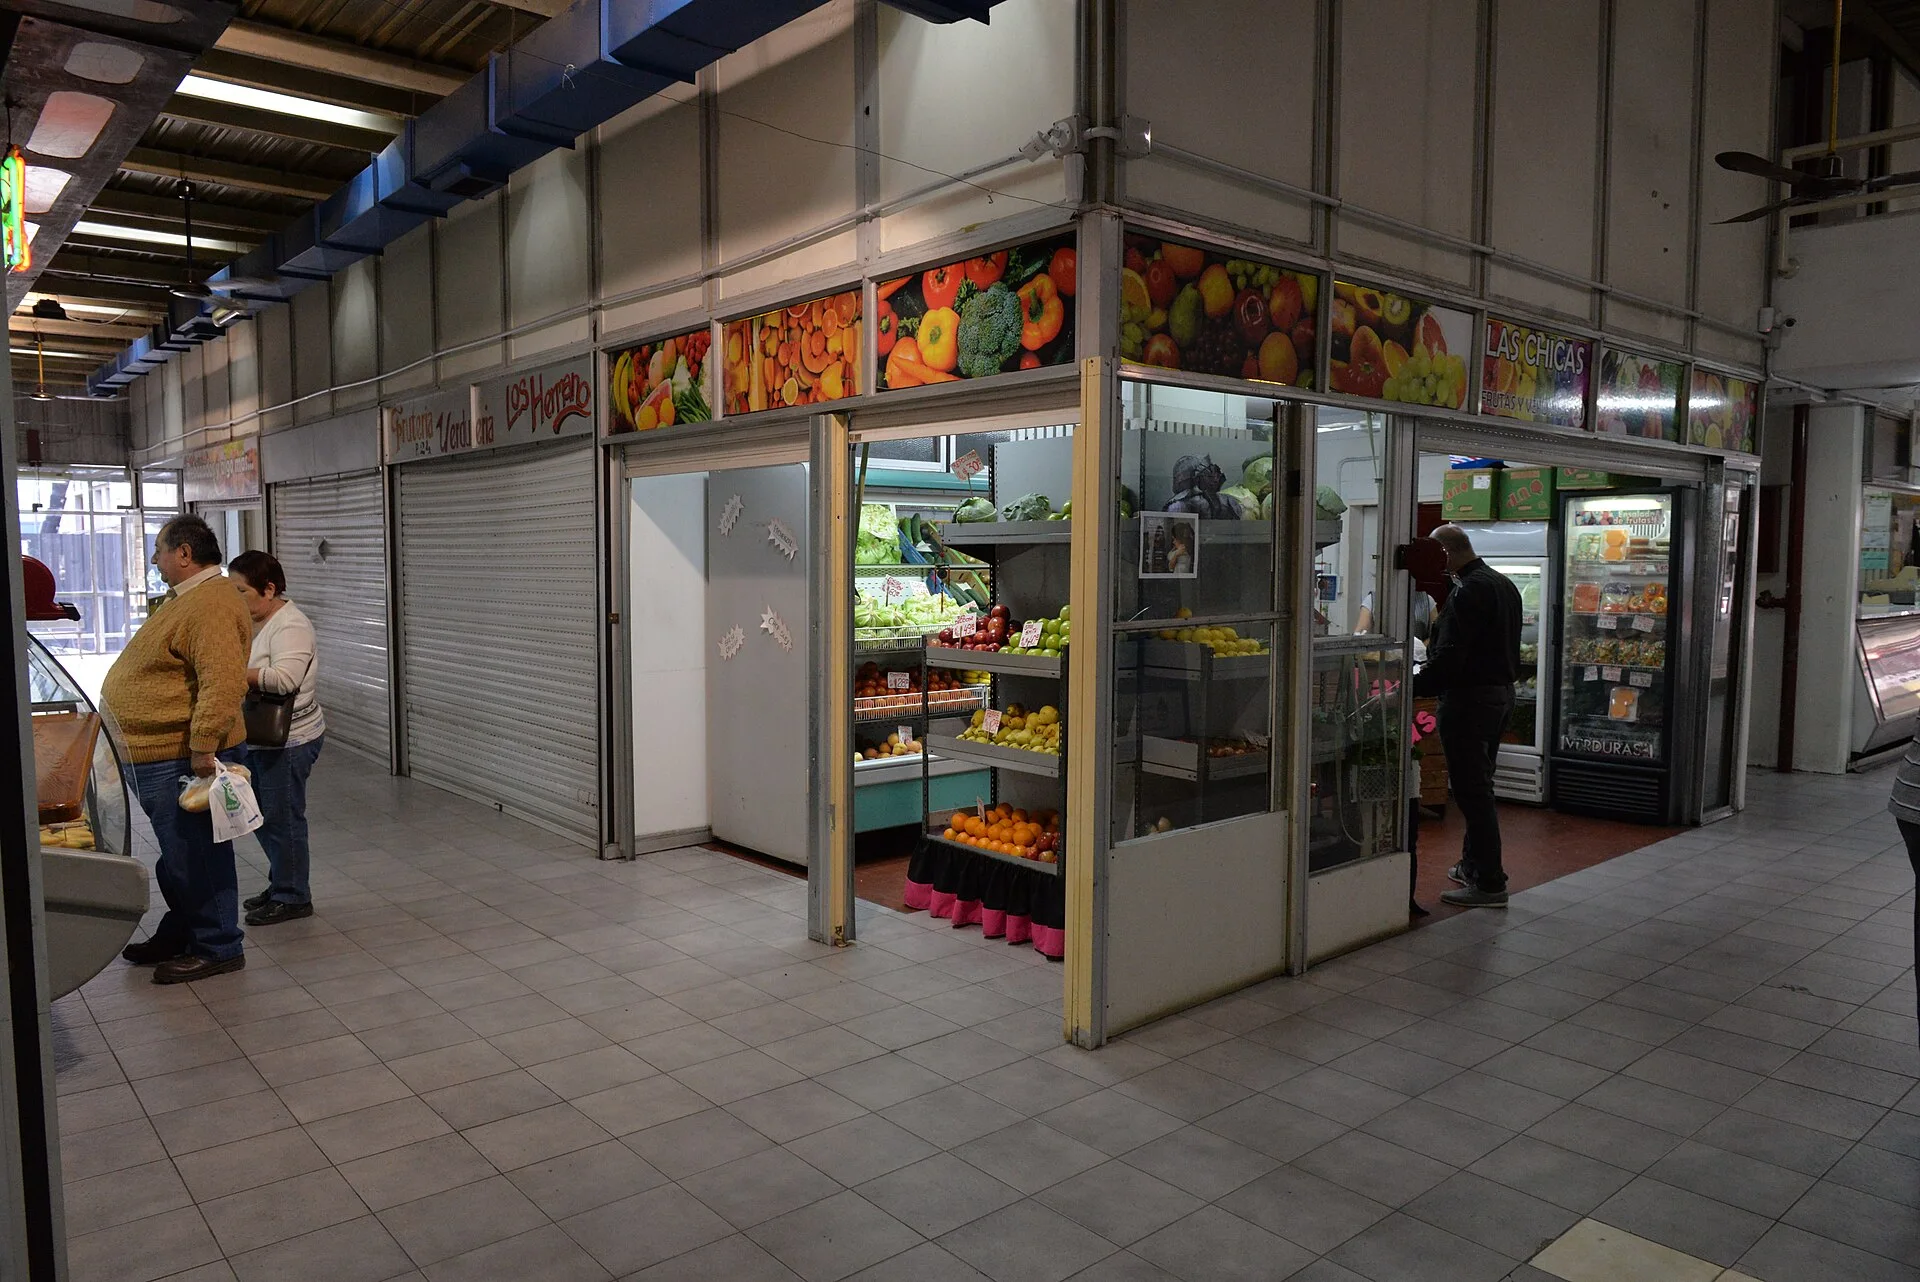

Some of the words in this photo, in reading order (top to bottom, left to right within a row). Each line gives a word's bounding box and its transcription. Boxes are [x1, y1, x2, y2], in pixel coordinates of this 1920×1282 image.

[1486, 324, 1520, 361] LAS
[1524, 333, 1585, 375] CHICAS
[1481, 390, 1516, 410] FRUTAS
[1517, 397, 1524, 411] Y
